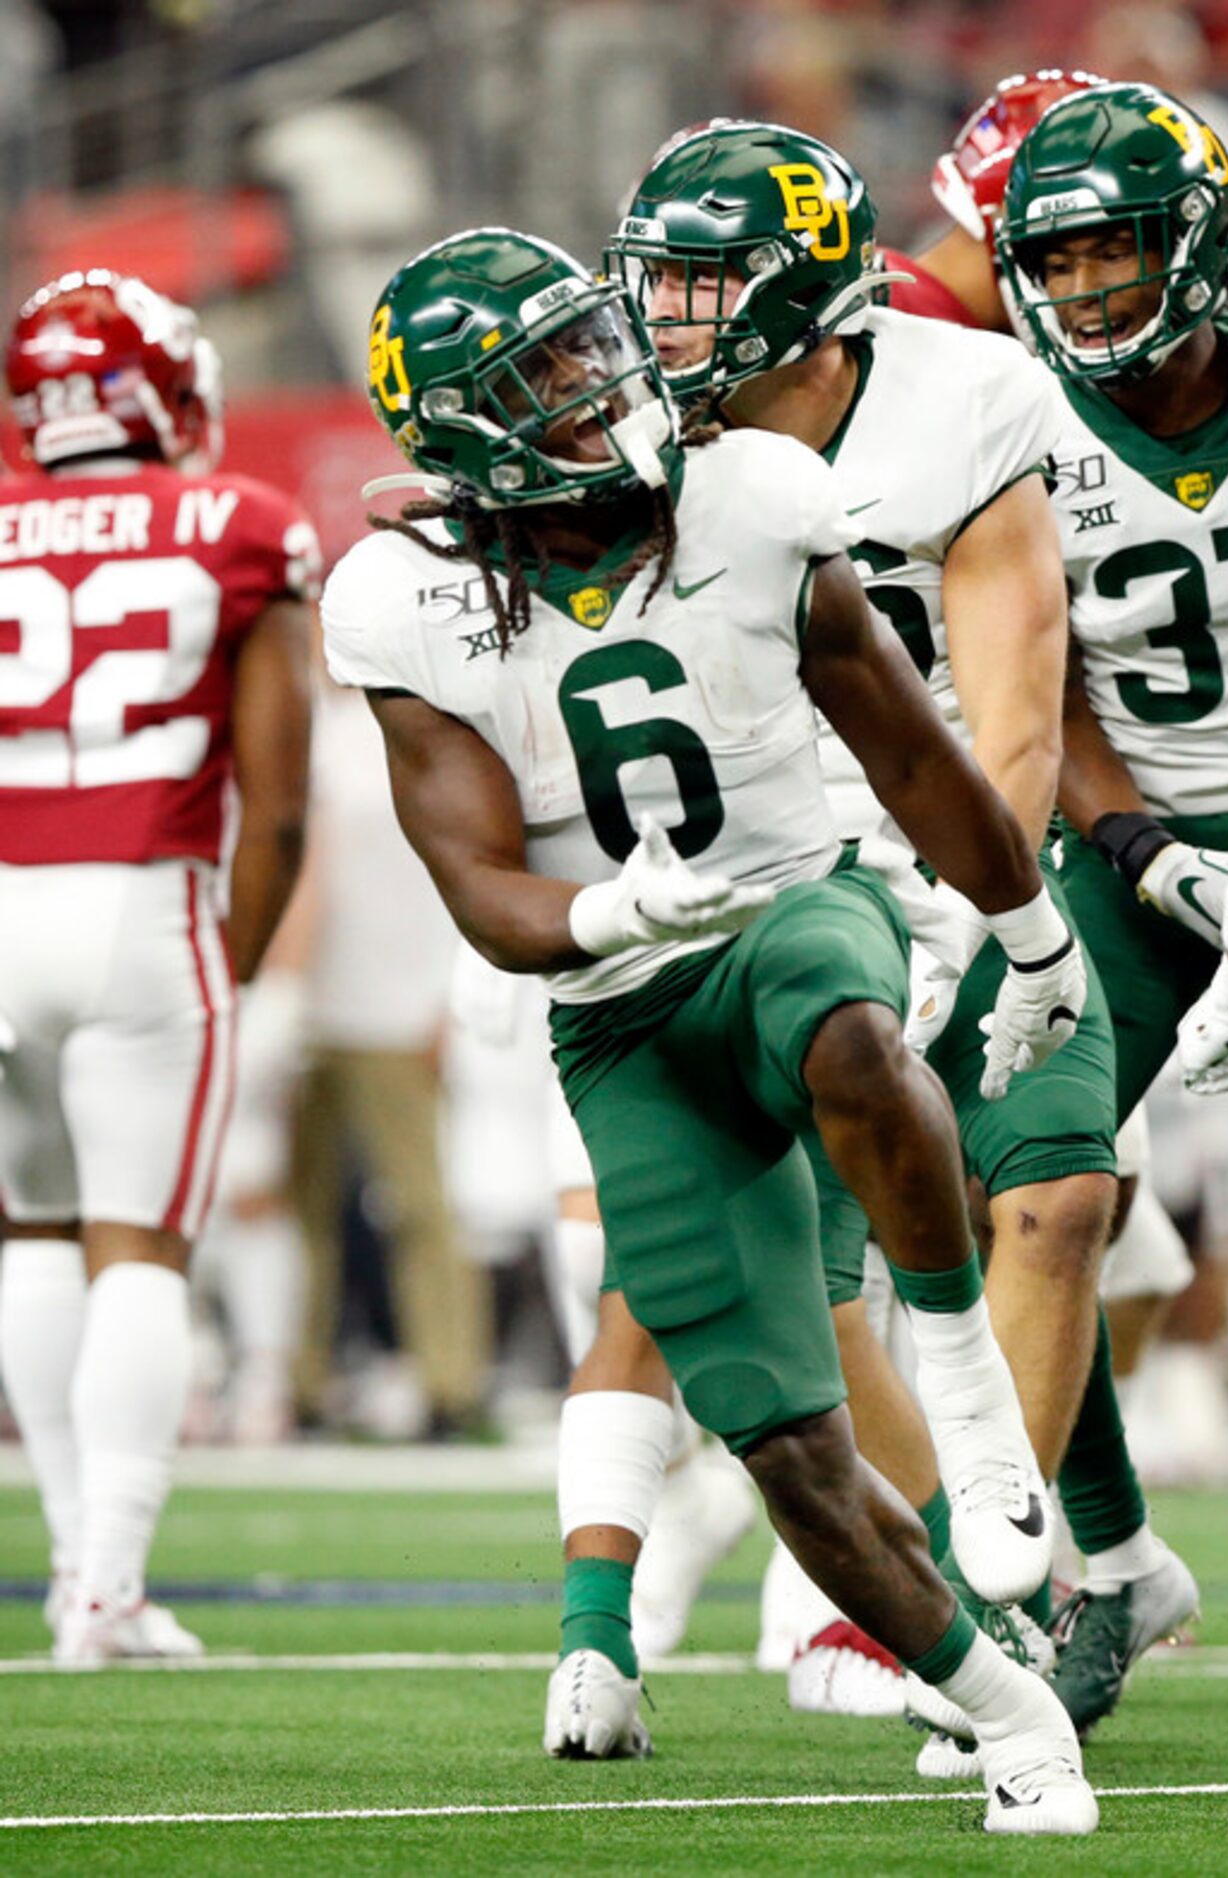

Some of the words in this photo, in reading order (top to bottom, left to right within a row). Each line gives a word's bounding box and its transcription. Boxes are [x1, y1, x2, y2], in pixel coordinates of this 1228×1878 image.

[769, 163, 850, 261] BU
[369, 304, 412, 412] BU
[174, 488, 239, 545] IV
[1070, 500, 1120, 533] XII
[558, 639, 725, 864] 6
